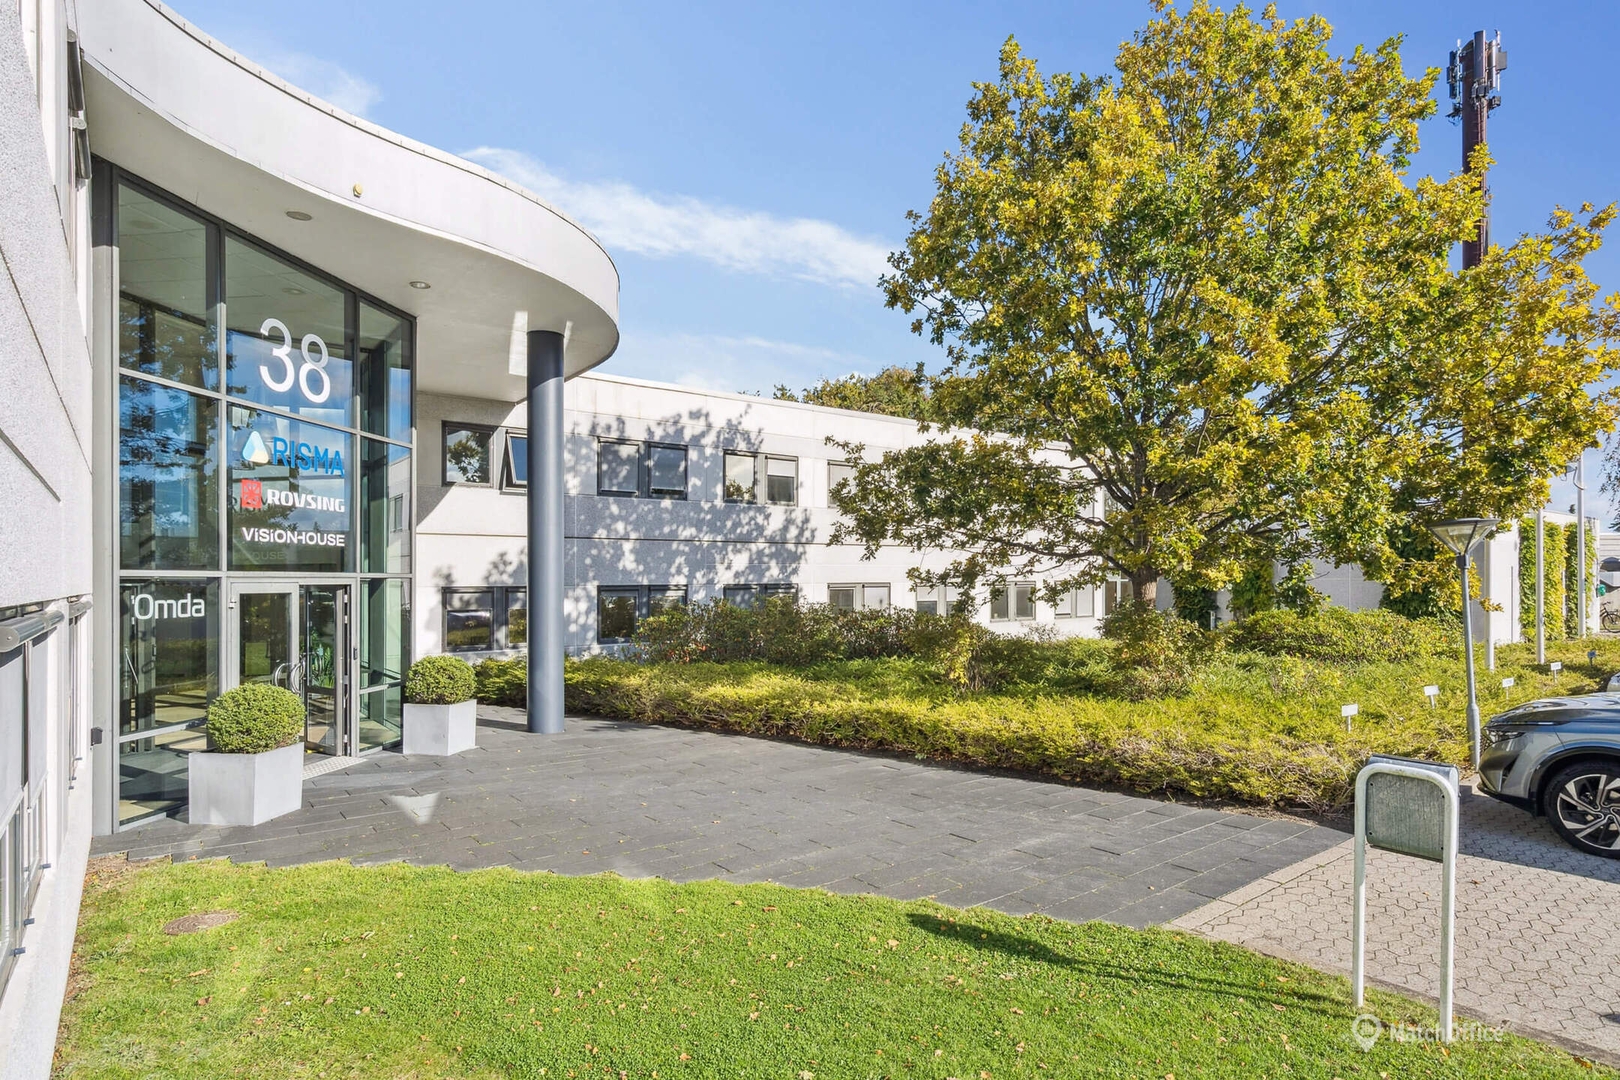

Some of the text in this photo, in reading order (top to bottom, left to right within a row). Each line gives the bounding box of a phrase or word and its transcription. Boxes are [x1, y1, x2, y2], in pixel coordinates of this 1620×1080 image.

[260, 318, 331, 403] 38
[272, 436, 345, 477] RISMA
[267, 489, 345, 513] ROVSING
[134, 593, 205, 620] Omda
